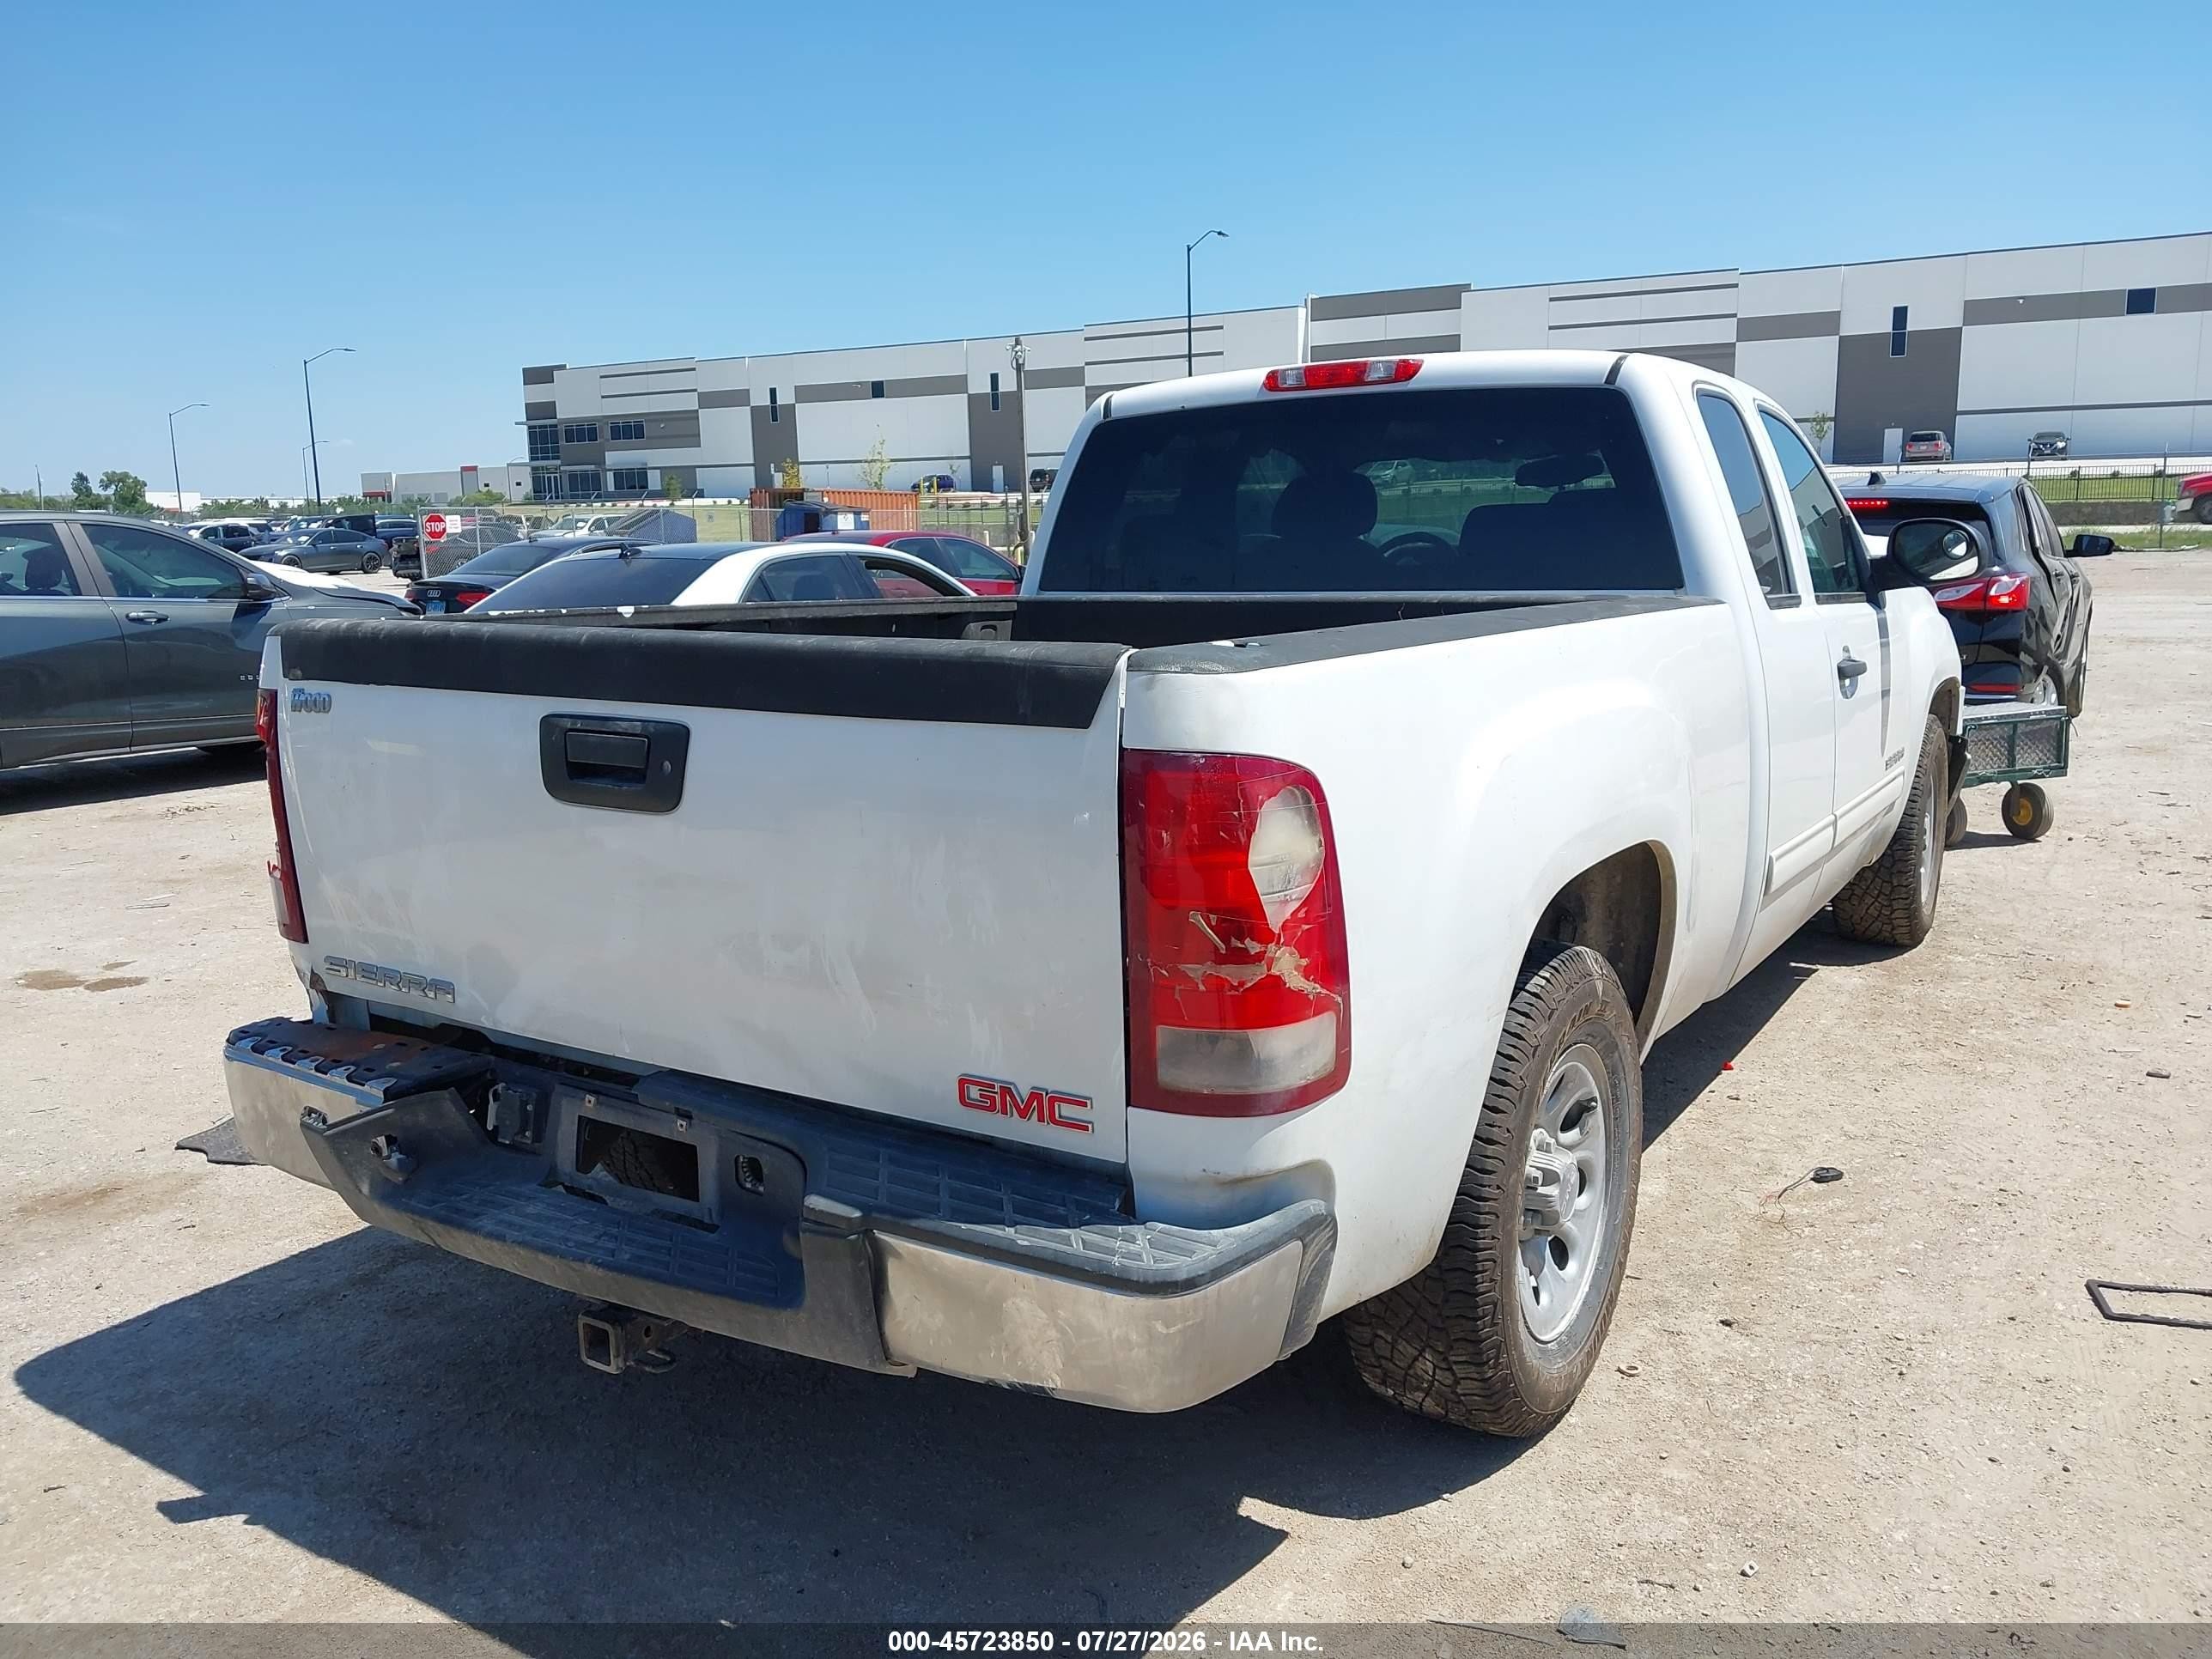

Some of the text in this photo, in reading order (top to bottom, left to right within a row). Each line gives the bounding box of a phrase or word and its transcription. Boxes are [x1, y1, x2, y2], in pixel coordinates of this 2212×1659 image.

[425, 521, 446, 532] STOP
[324, 955, 455, 1003] SIERRA
[957, 1073, 1094, 1133] GMC
